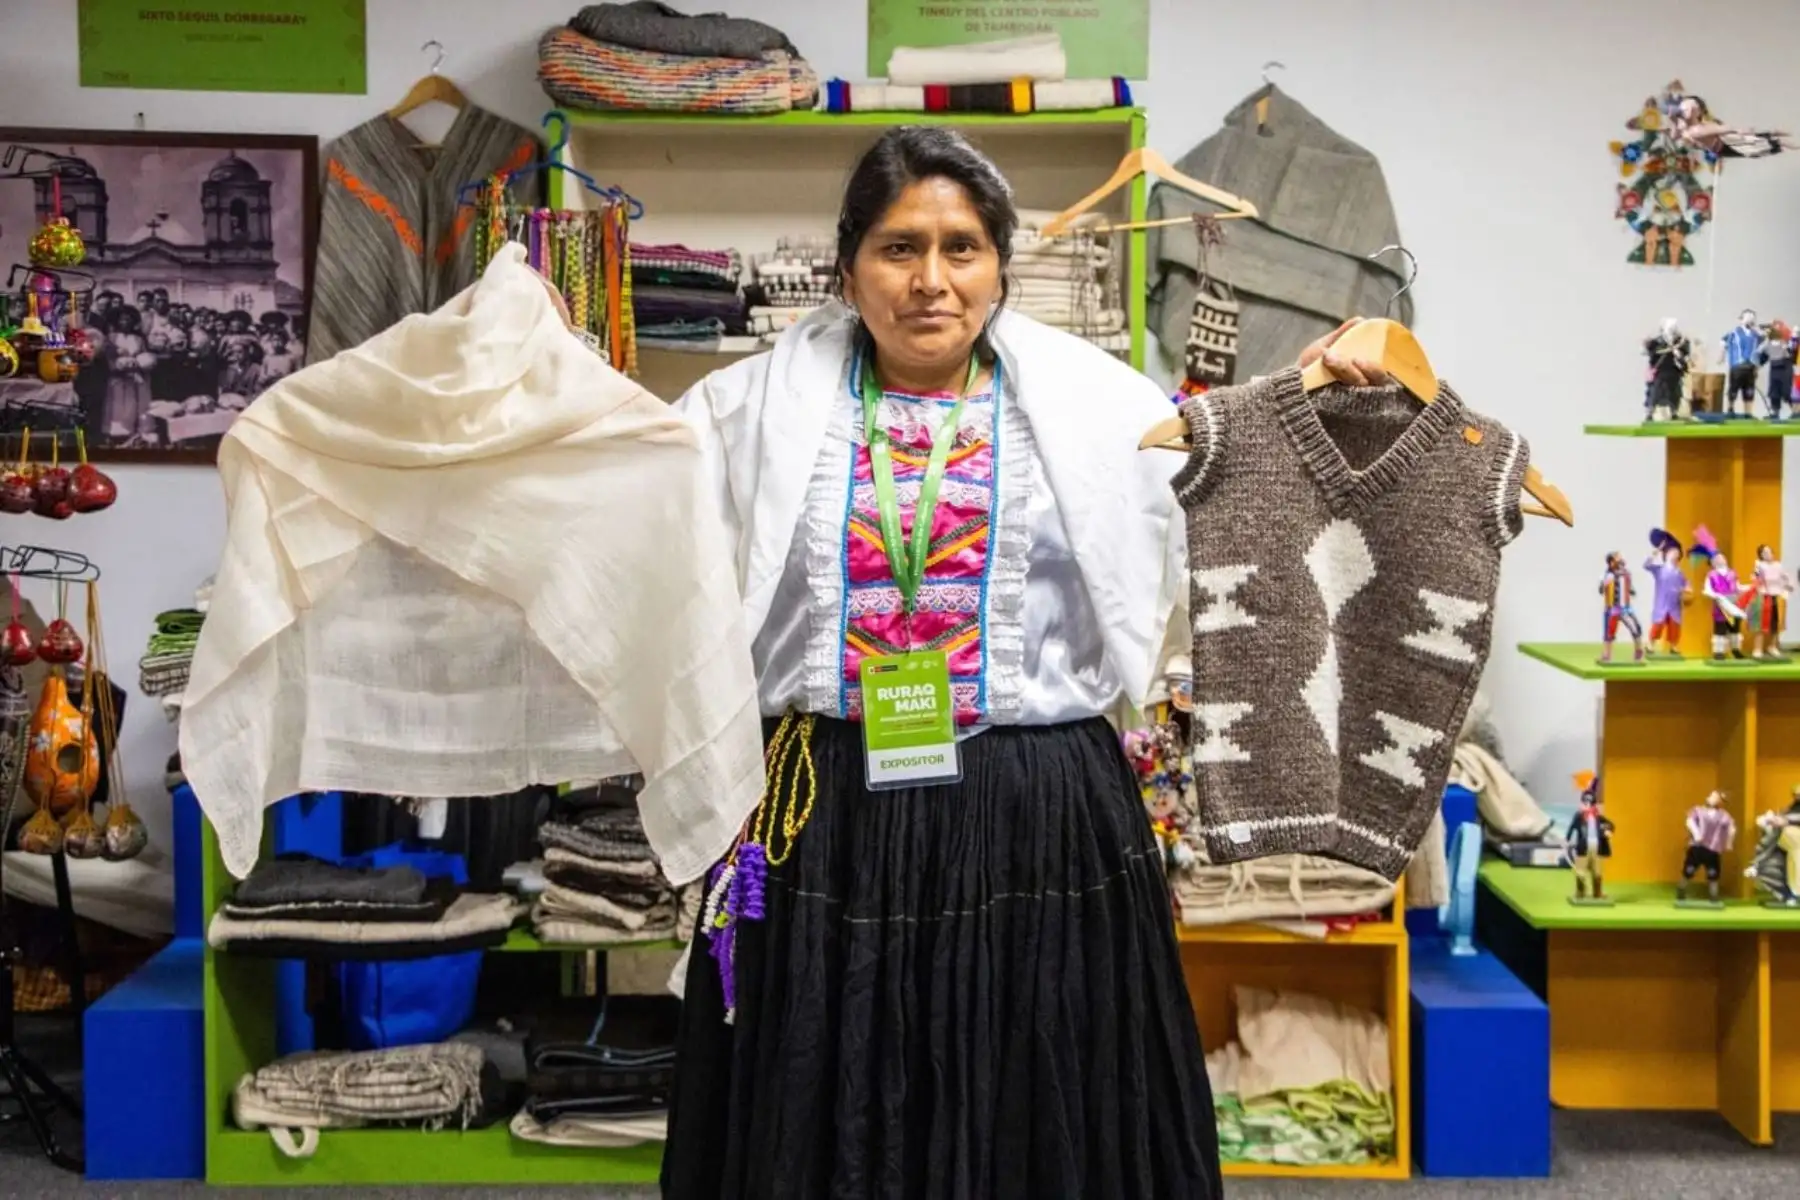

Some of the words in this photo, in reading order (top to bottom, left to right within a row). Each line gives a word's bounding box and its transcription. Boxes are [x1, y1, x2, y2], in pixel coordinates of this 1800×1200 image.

[965, 7, 986, 18] DEL
[989, 7, 1038, 18] CENTRO
[1041, 8, 1099, 18] POBLADO
[965, 22, 980, 33] DE
[877, 683, 936, 701] RURAQ
[895, 697, 937, 713] MAKI
[880, 754, 944, 770] EXPOSITOR
